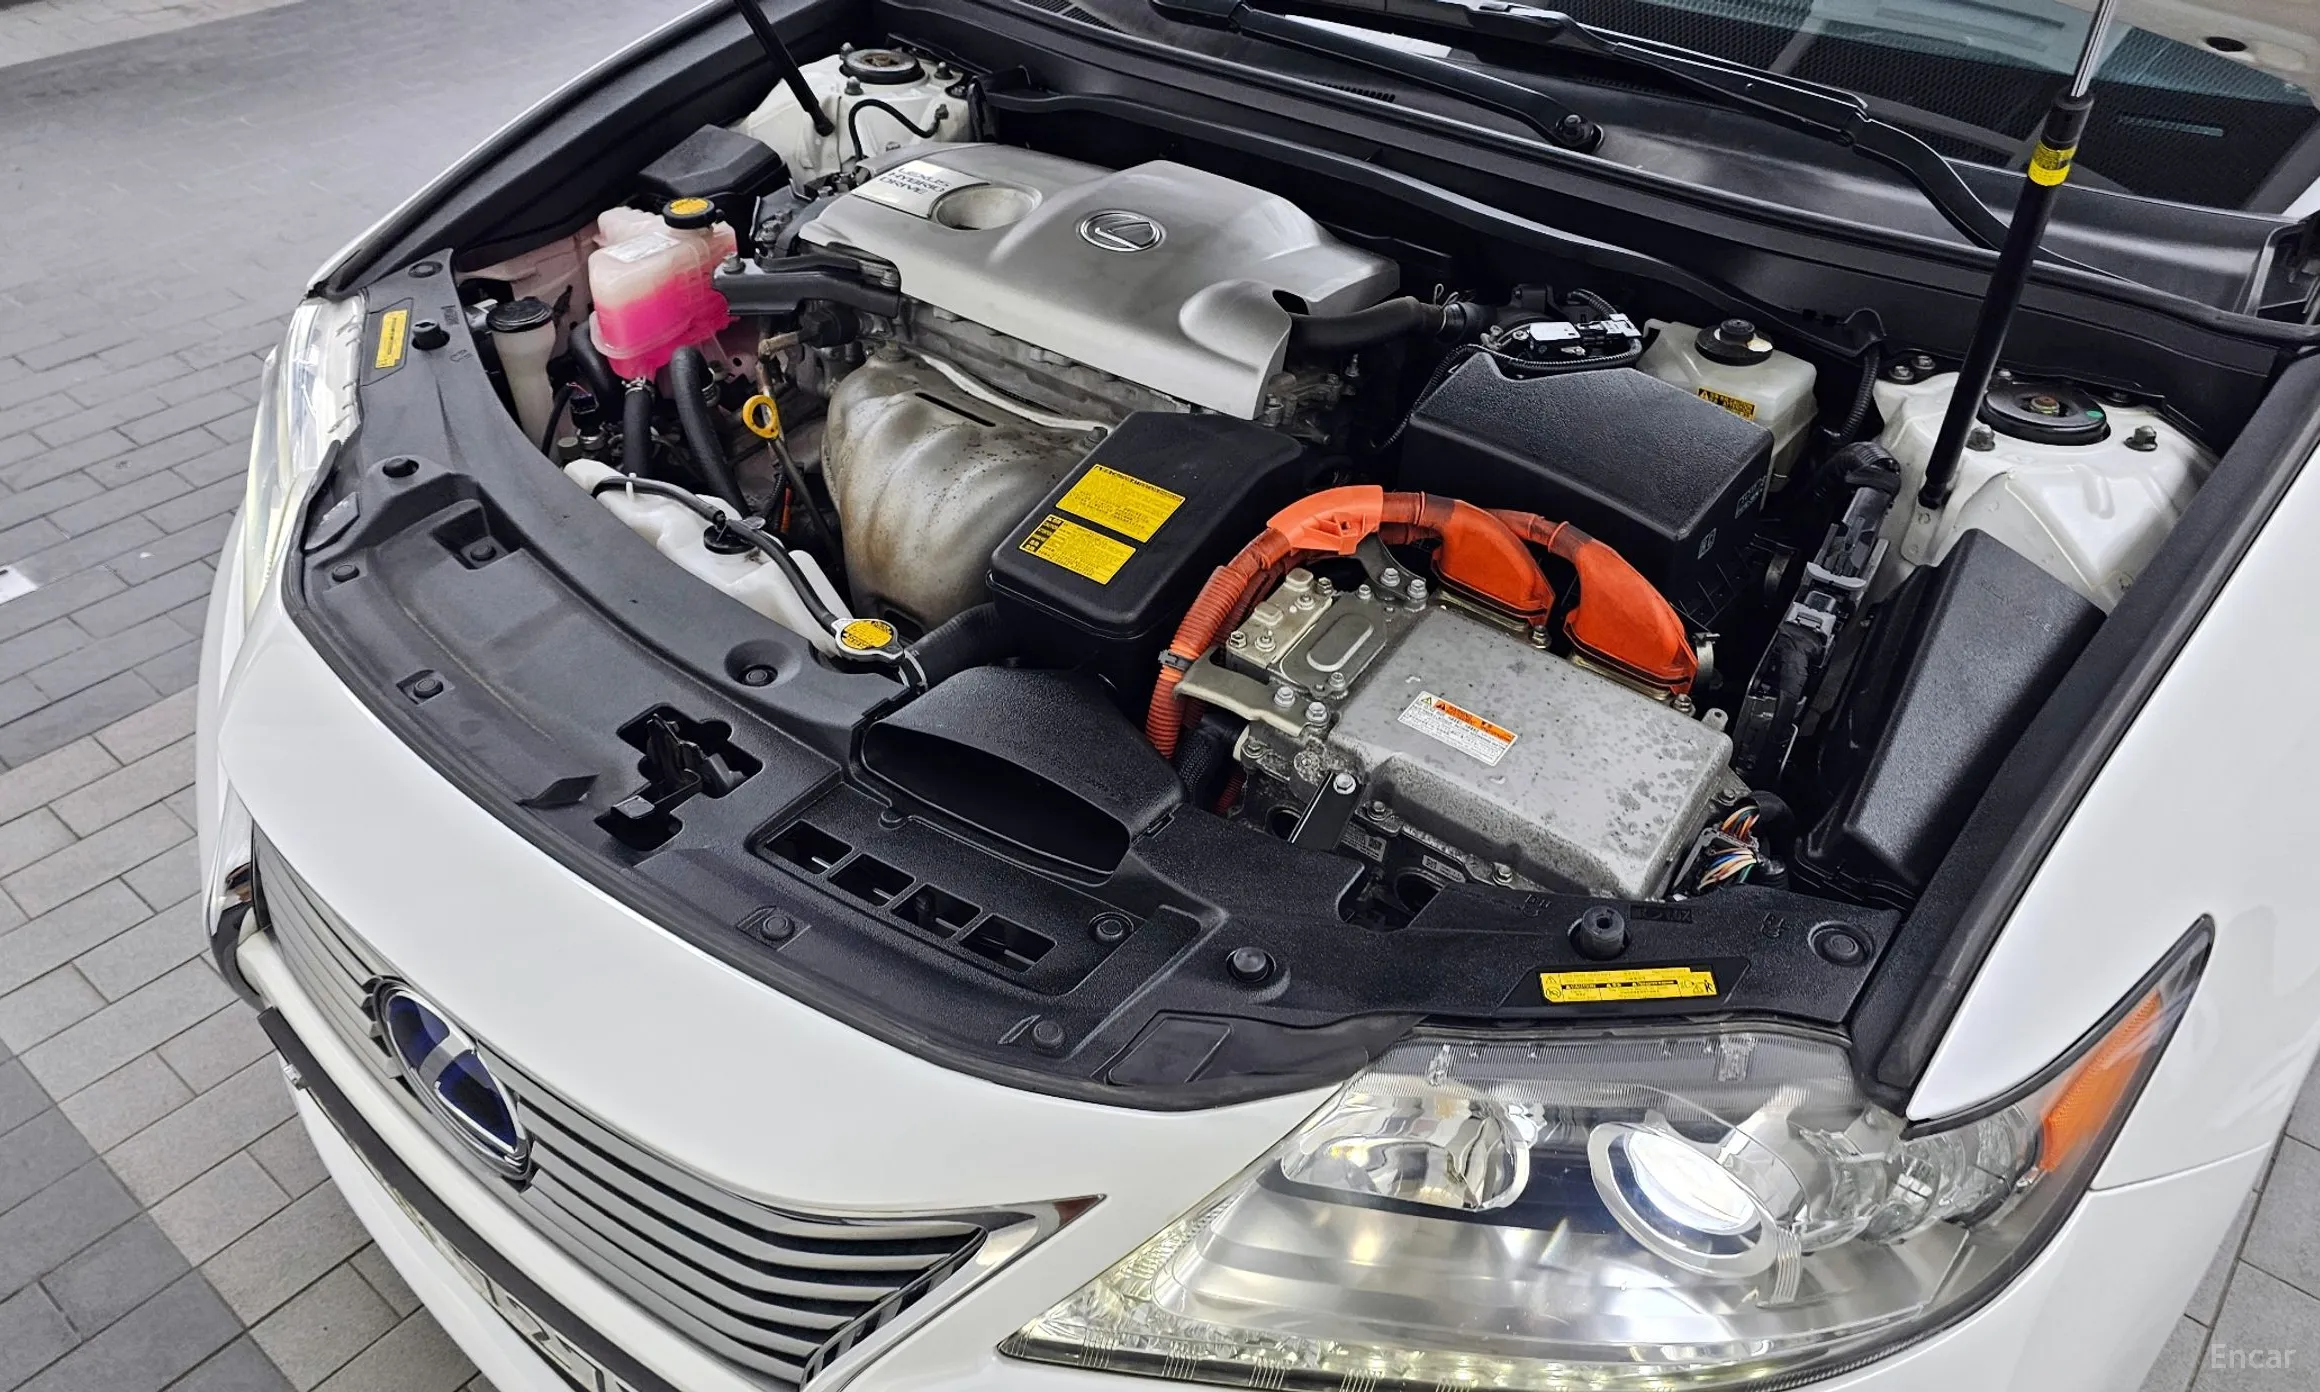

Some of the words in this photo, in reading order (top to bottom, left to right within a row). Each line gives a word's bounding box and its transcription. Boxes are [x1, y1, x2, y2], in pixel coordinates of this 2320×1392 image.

[879, 176, 928, 195] DRIVE
[888, 172, 945, 193] HYBRID
[898, 168, 952, 187] LEXUS
